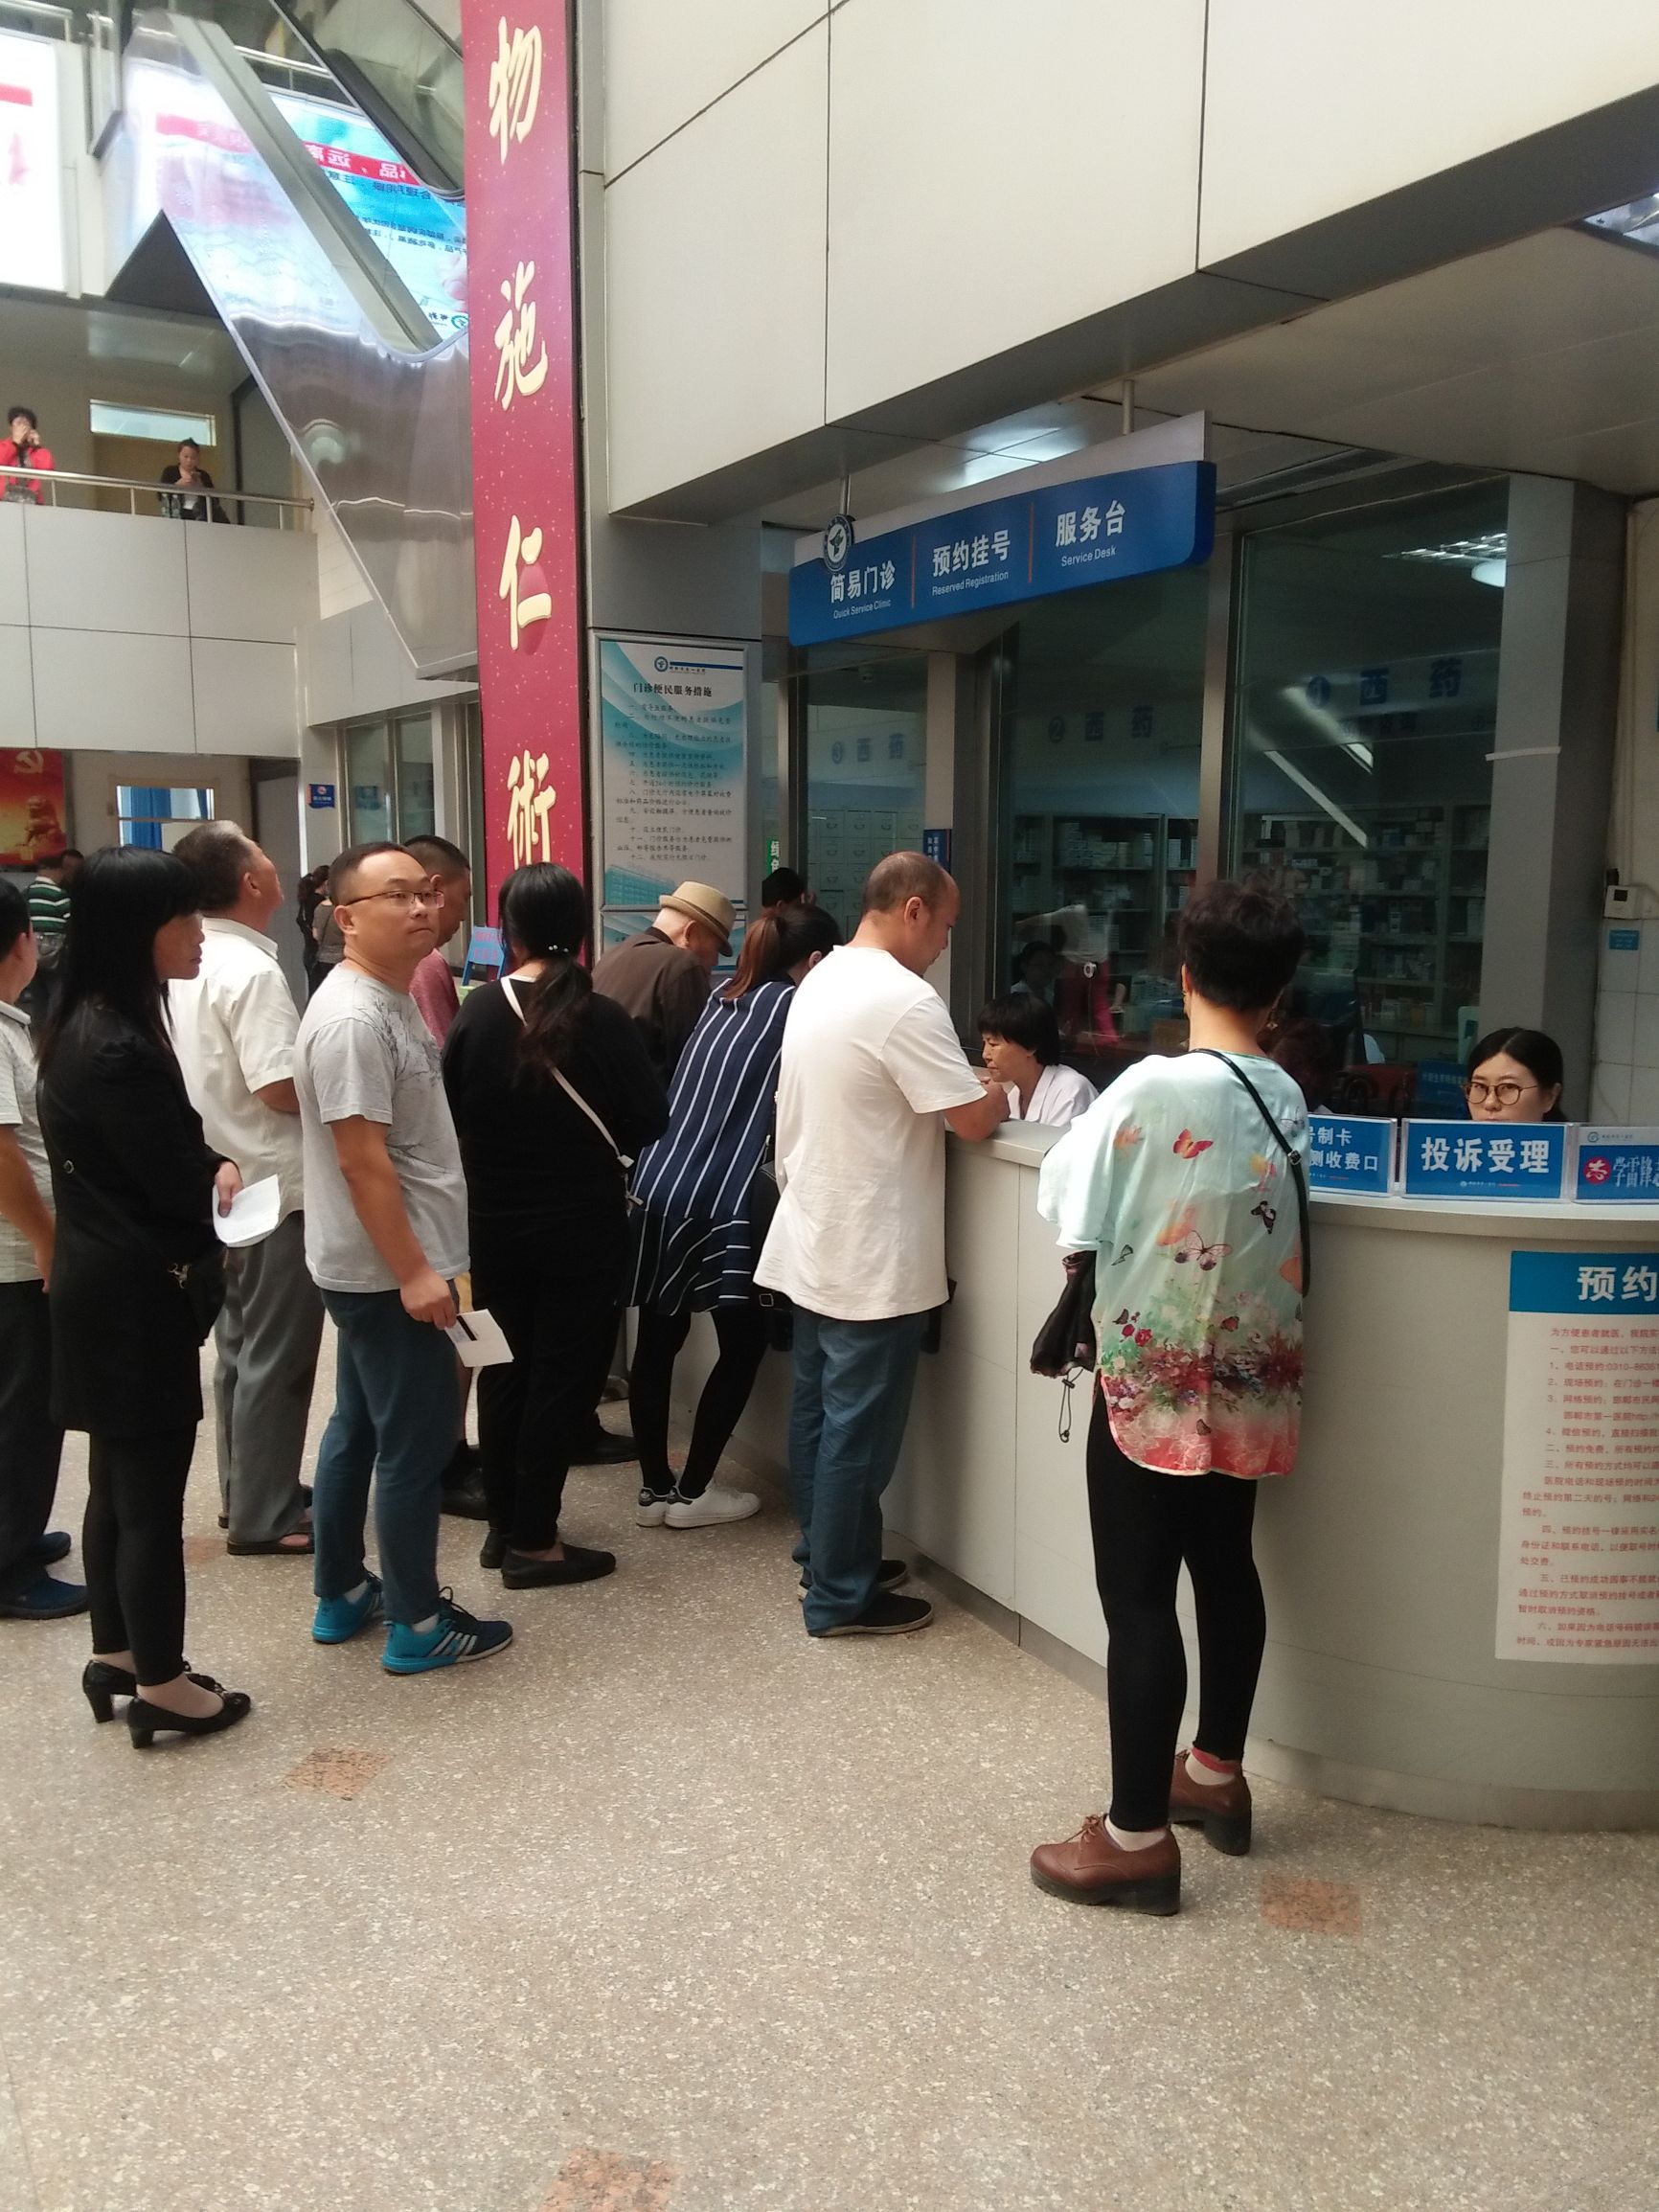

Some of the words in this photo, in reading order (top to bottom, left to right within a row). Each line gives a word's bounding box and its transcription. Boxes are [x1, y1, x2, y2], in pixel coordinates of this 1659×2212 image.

[1056, 500, 1125, 547] 服务台
[932, 529, 1011, 578] 预约挂号
[1061, 553, 1093, 567] Service
[1095, 545, 1116, 560] Desk
[830, 559, 896, 604] 简易门诊
[932, 582, 965, 596] Reserved
[966, 571, 1009, 588] Registration
[833, 606, 851, 619] Quick
[851, 602, 873, 615] Service
[874, 599, 892, 610] Clinic
[633, 683, 713, 697] 门诊便民服务措施
[1420, 1136, 1550, 1174] 投诉受理
[1577, 1266, 1658, 1302] 预约
